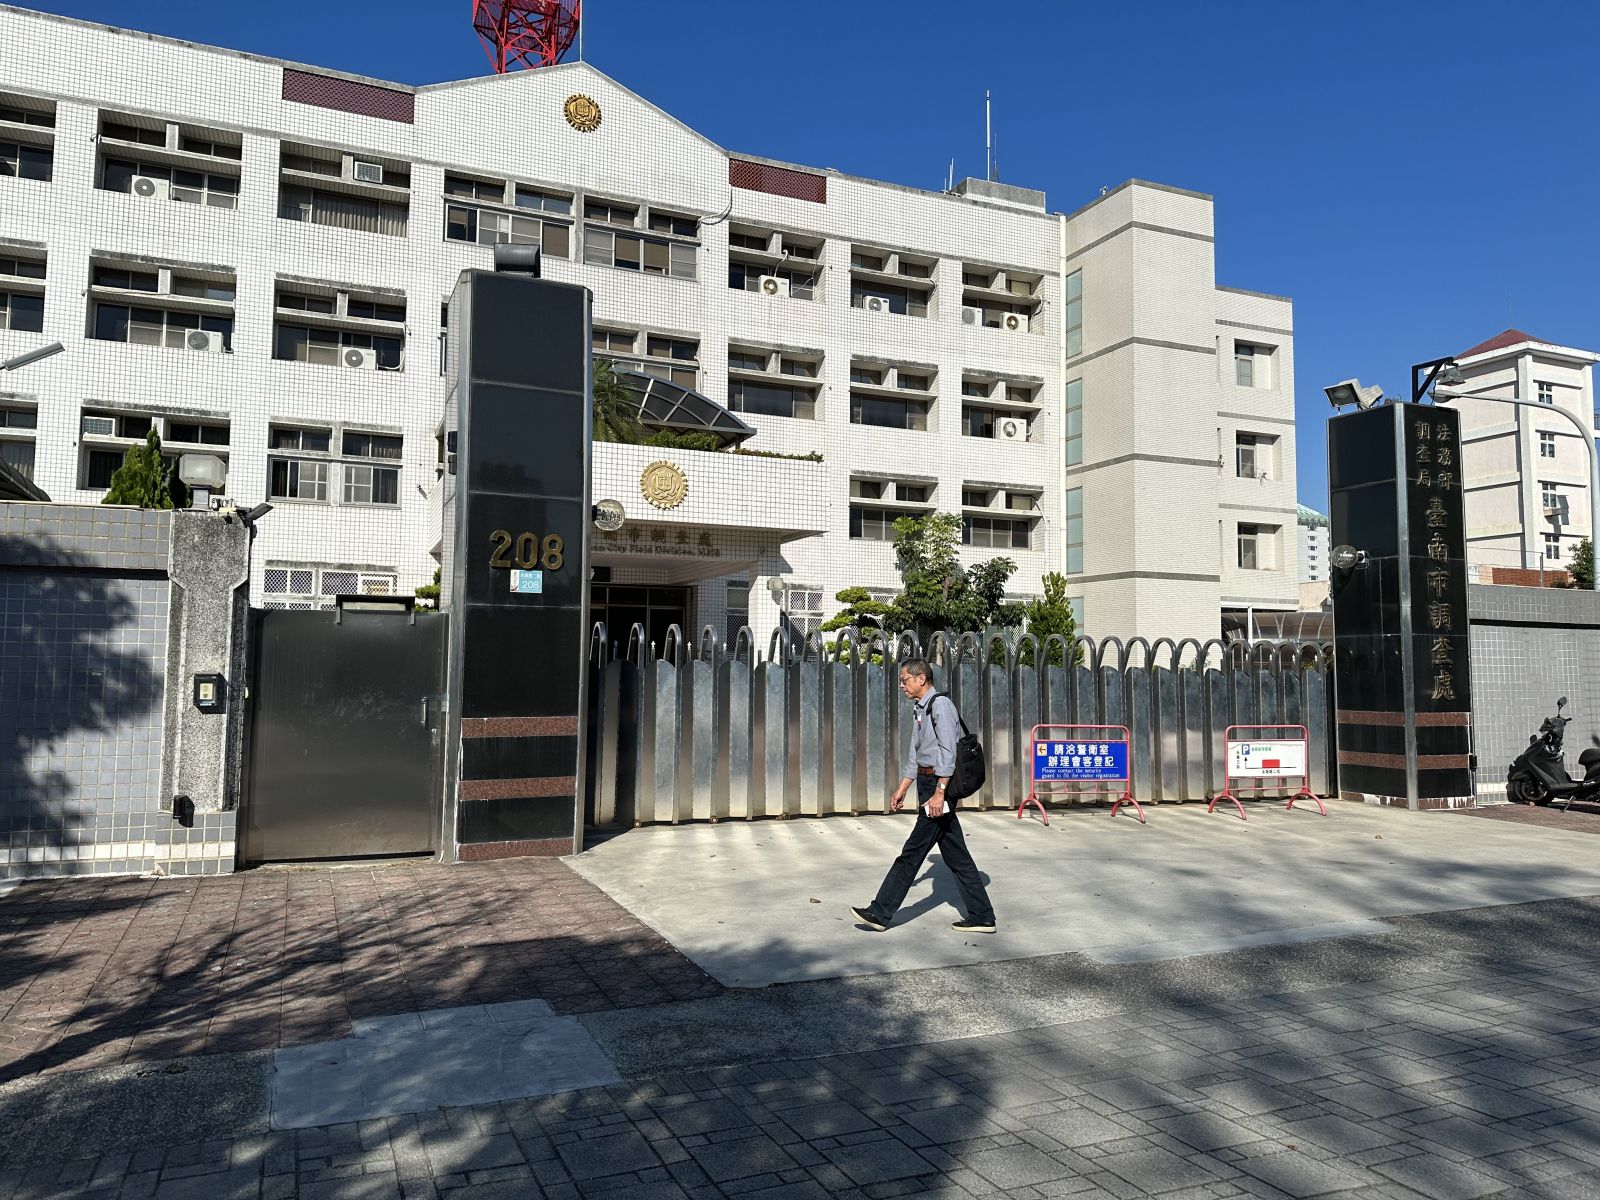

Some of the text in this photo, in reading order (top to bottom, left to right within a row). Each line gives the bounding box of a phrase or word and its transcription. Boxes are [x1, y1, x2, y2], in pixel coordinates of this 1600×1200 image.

[1415, 420, 1432, 488] 調查局
[1436, 423, 1453, 490] 法務部
[490, 529, 564, 570] 208
[522, 580, 539, 589] 208
[1424, 496, 1456, 701] 臺南市調查處
[1048, 756, 1114, 767] 辦理會客登記
[1054, 744, 1109, 755] 請洽警衛室
